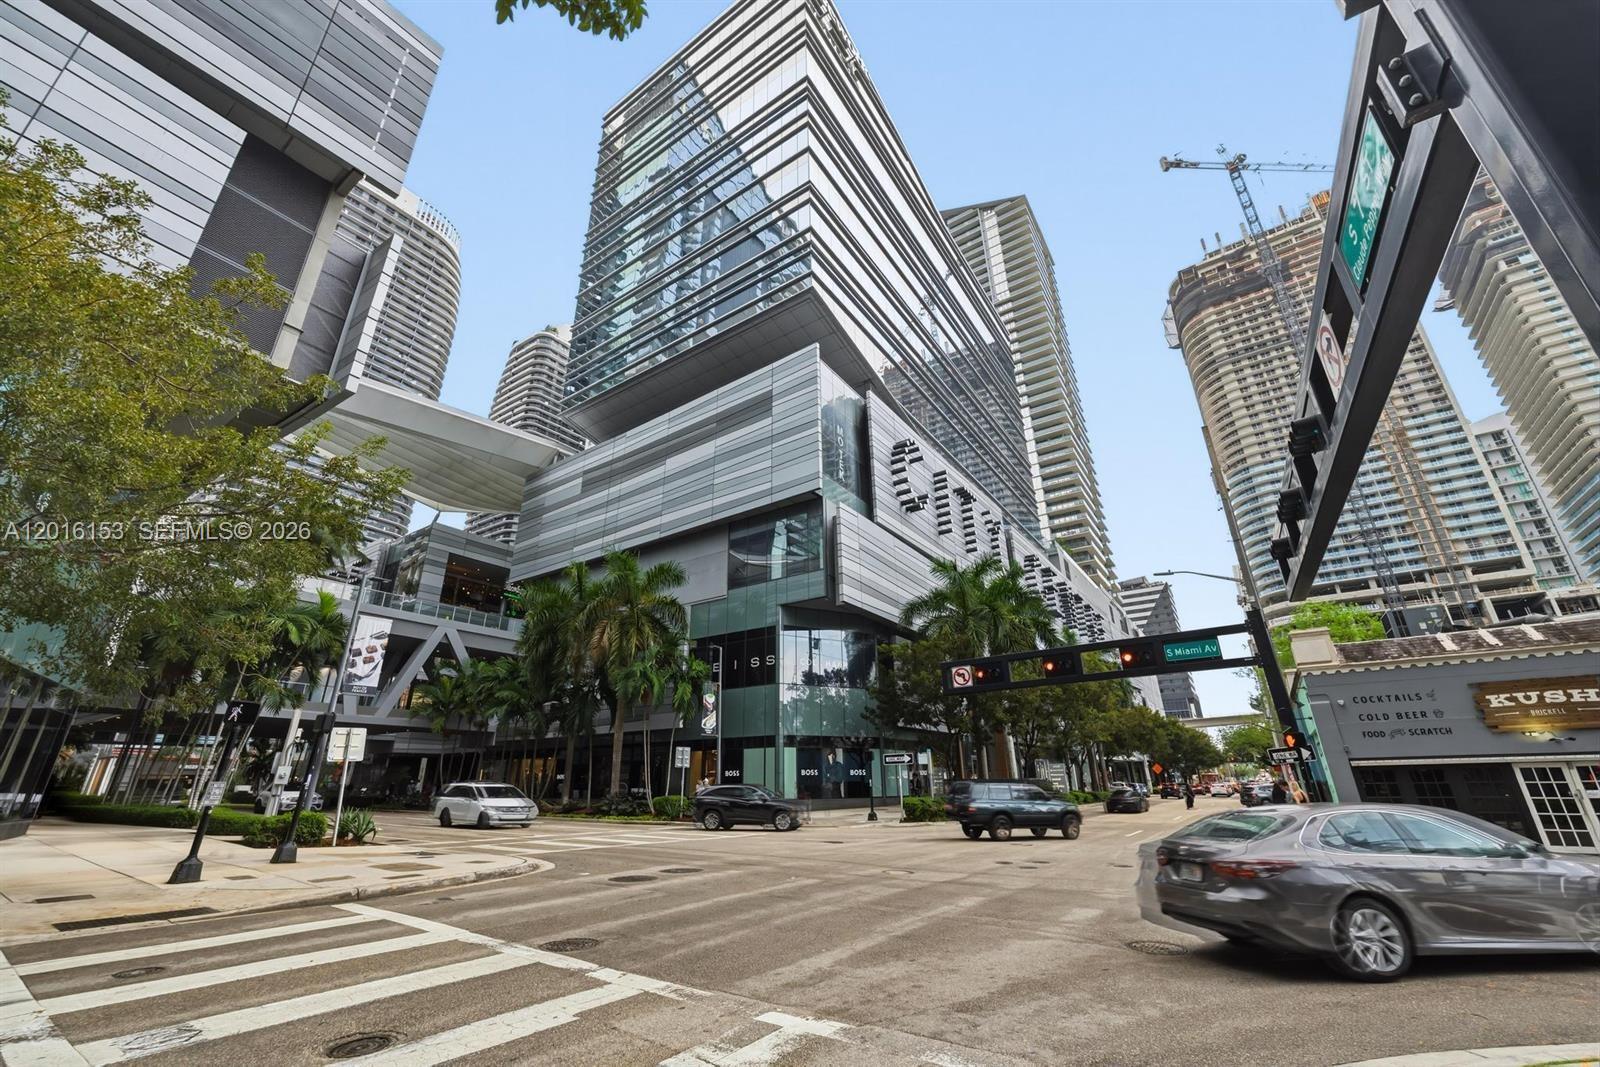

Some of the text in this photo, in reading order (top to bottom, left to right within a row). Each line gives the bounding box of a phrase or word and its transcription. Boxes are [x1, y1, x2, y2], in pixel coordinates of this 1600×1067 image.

[1348, 223, 1358, 246] S
[1352, 237, 1368, 281] Claude
[1166, 644, 1217, 657] S Miami Av
[712, 655, 775, 673] EISS
[1352, 693, 1422, 704] COCKTAILS
[1485, 688, 1600, 708] KUSH
[1358, 710, 1428, 721] COLD BEER
[1529, 708, 1566, 717] BRICKELL
[1362, 730, 1386, 739] FOOD
[1408, 727, 1453, 736] SCRATCH
